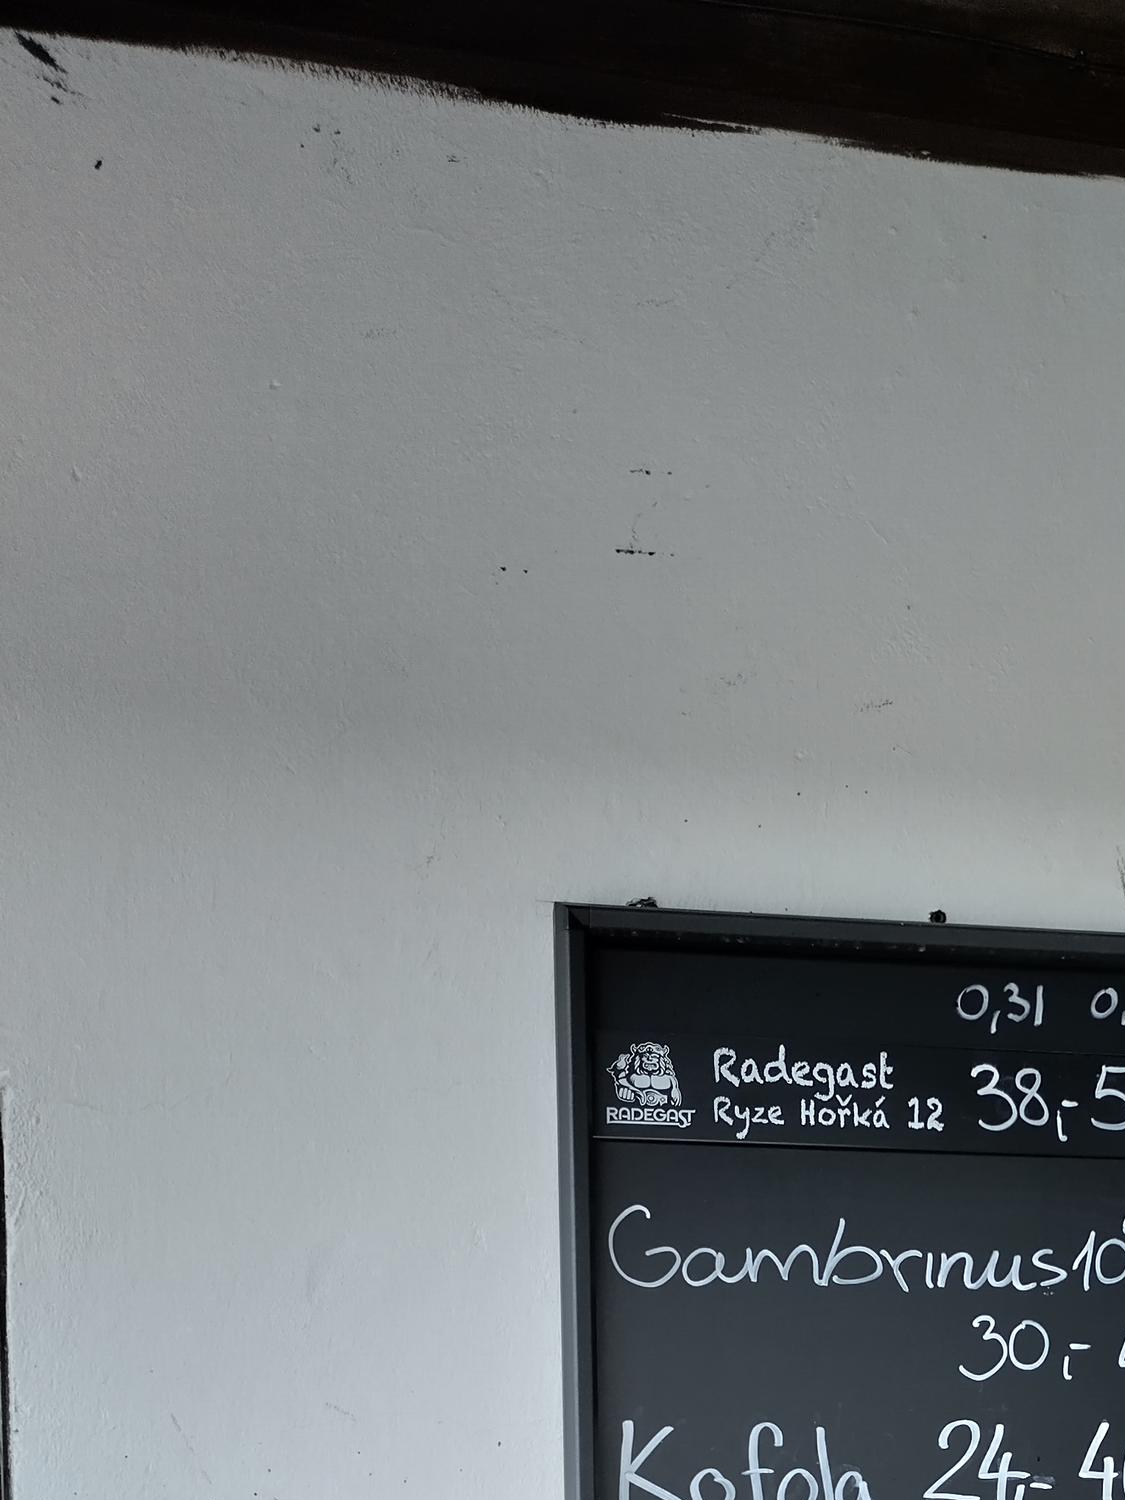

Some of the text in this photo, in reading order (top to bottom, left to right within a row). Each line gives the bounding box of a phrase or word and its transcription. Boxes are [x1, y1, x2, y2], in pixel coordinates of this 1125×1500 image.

[712, 1044, 895, 1101] Radegast
[606, 1106, 697, 1129] RADEGAST
[712, 1094, 946, 1140] Ryze Hořká 12
